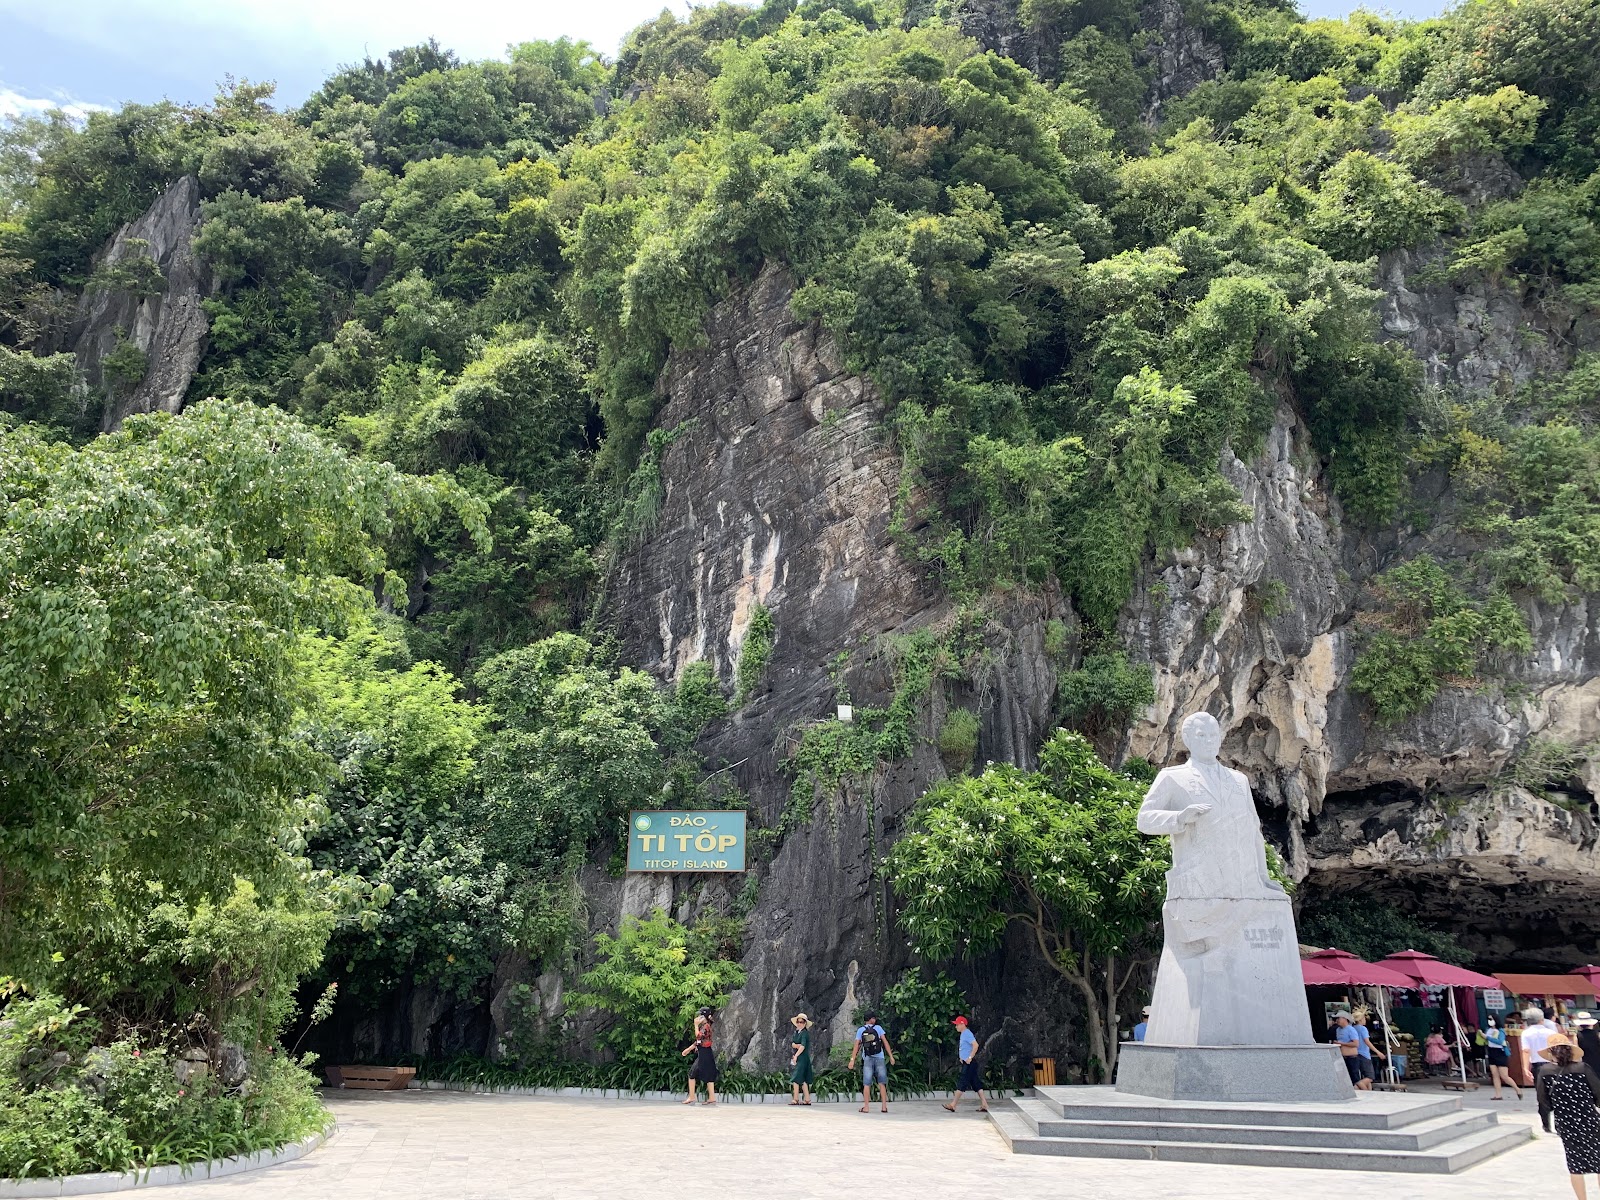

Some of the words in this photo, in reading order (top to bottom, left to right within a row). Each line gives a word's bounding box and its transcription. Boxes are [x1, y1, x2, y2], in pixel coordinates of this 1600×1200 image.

[670, 814, 706, 827] ĐẢO
[637, 834, 666, 852] TI
[674, 825, 737, 852] TỐP
[644, 860, 679, 869] TITOP
[683, 860, 728, 869] ISLAND
